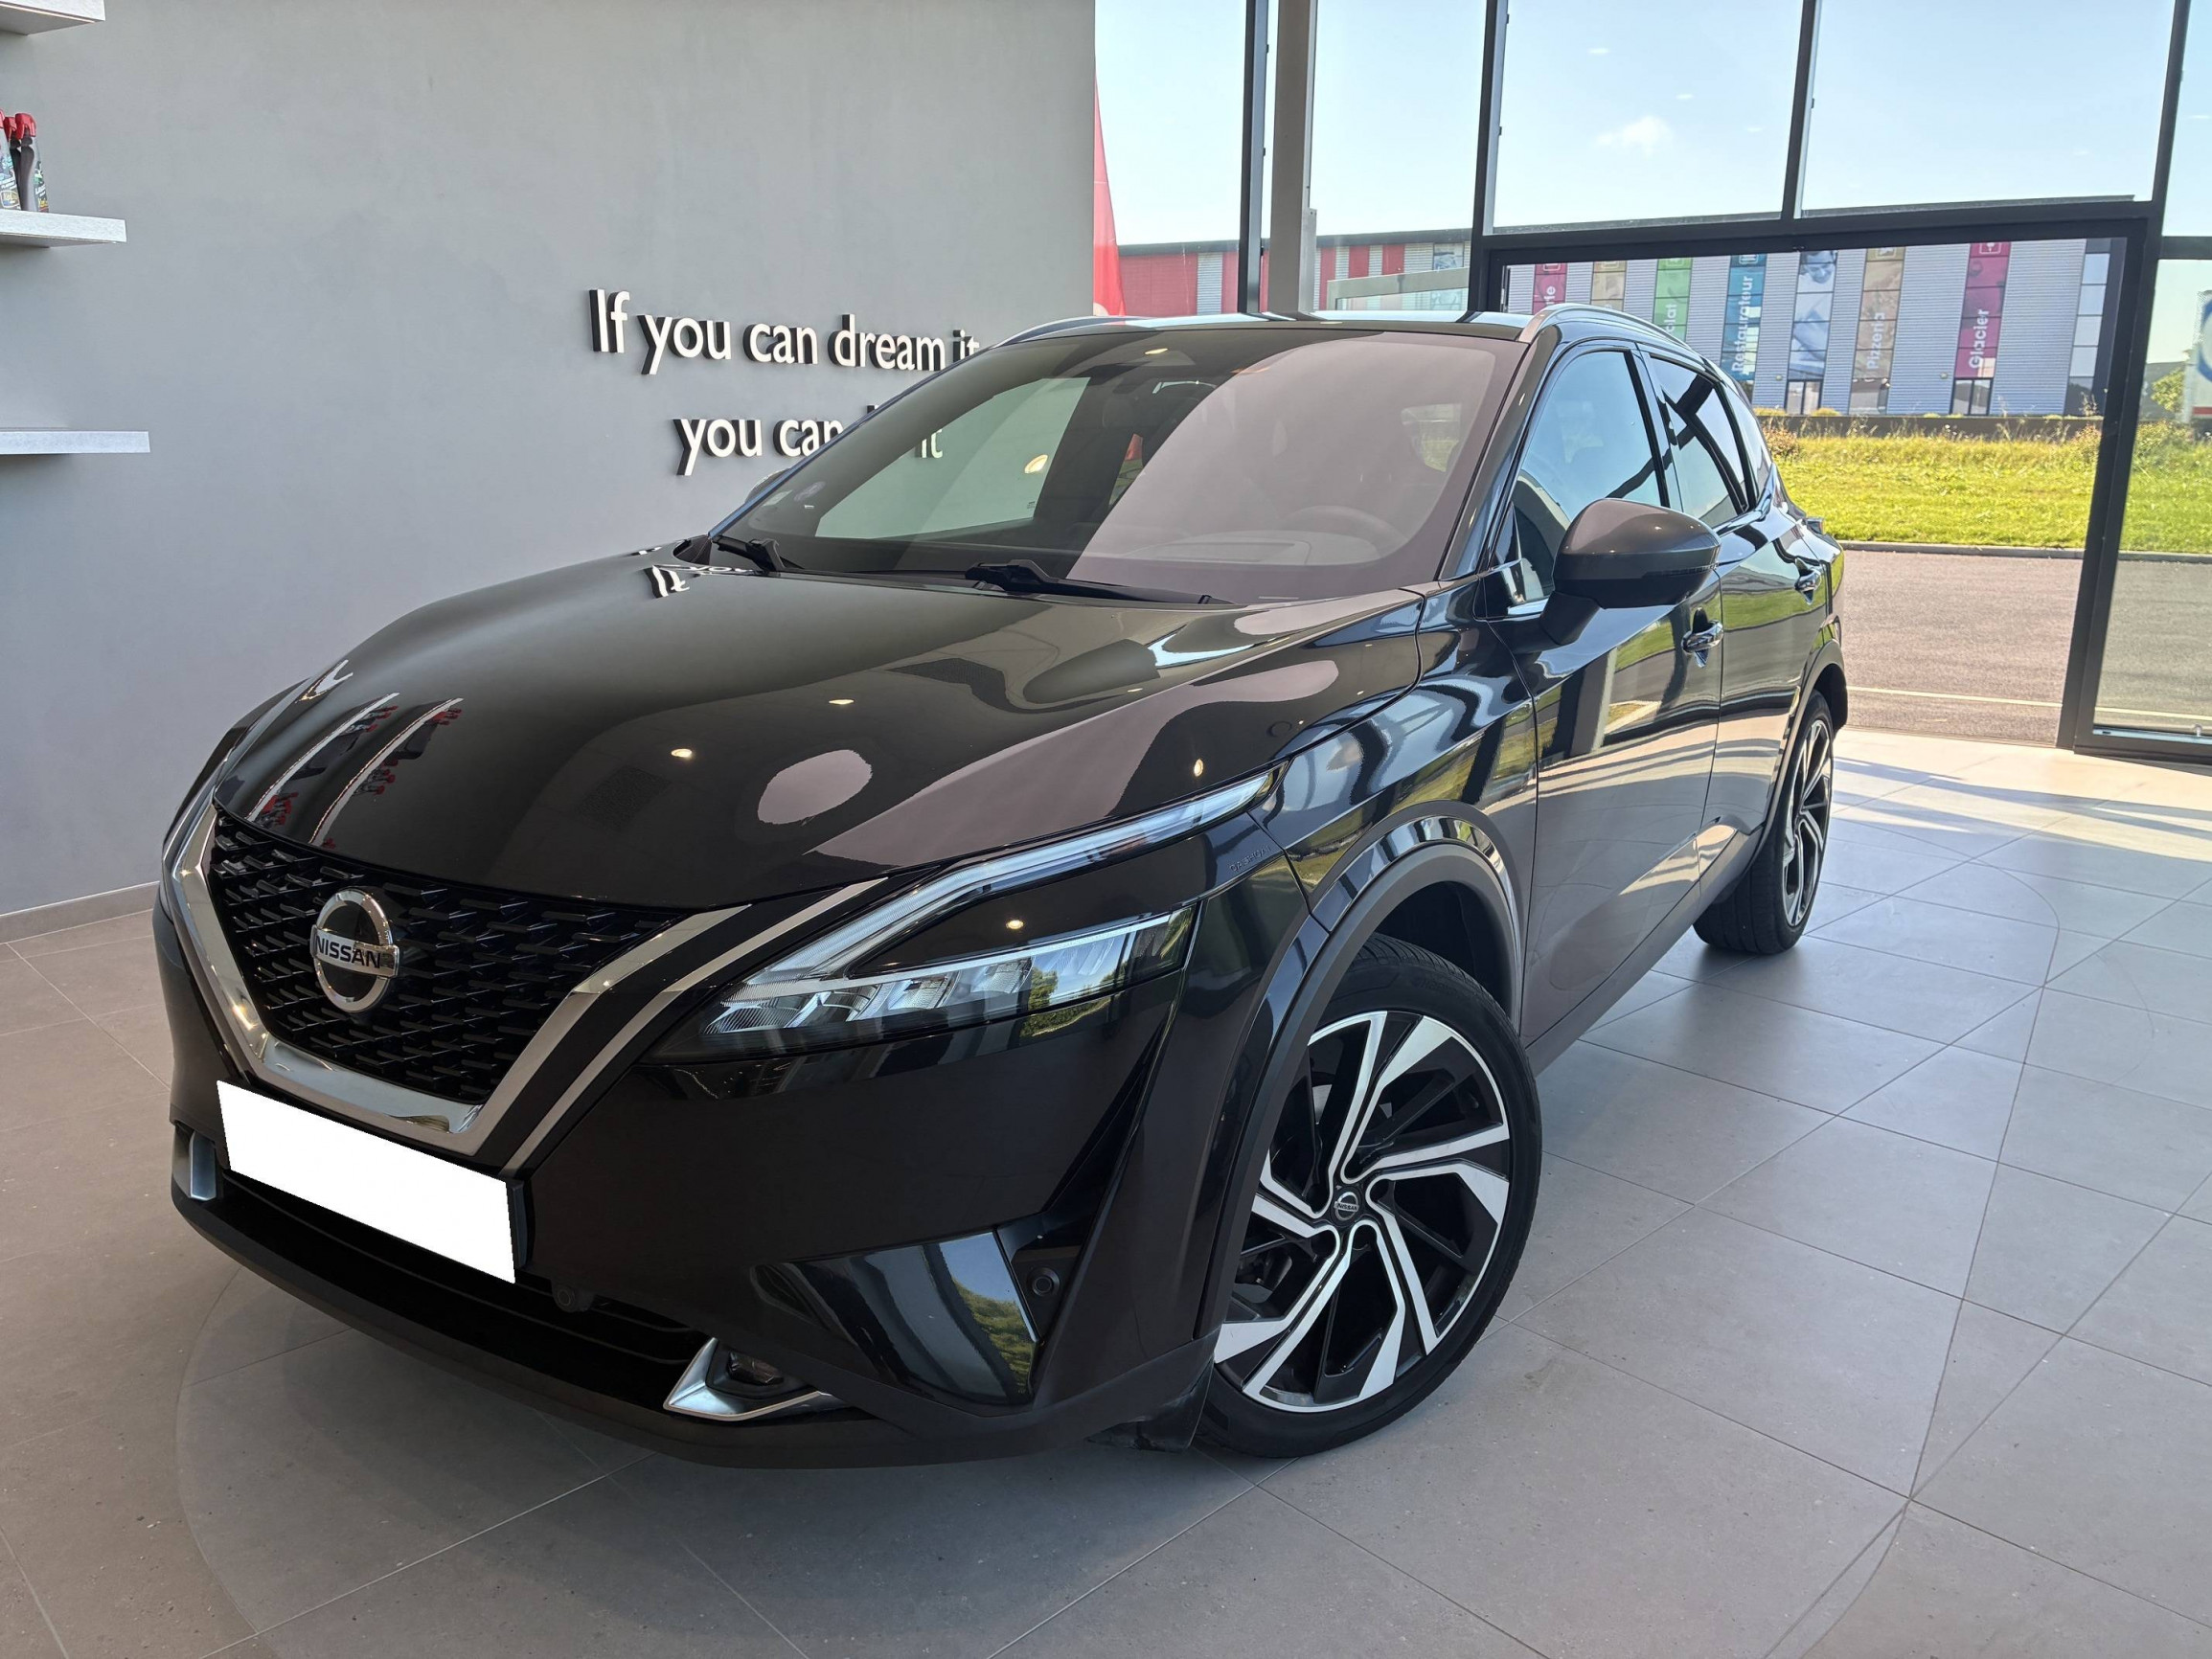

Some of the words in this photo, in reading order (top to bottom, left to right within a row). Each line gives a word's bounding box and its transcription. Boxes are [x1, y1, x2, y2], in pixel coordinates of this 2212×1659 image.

[589, 288, 630, 353] If
[637, 313, 731, 375] you
[743, 323, 818, 364] can
[828, 314, 946, 372] dream
[1866, 311, 1885, 370] Pizzeria
[1968, 308, 1990, 369] Glacier
[673, 419, 763, 476] you
[316, 935, 381, 969] NISSAN
